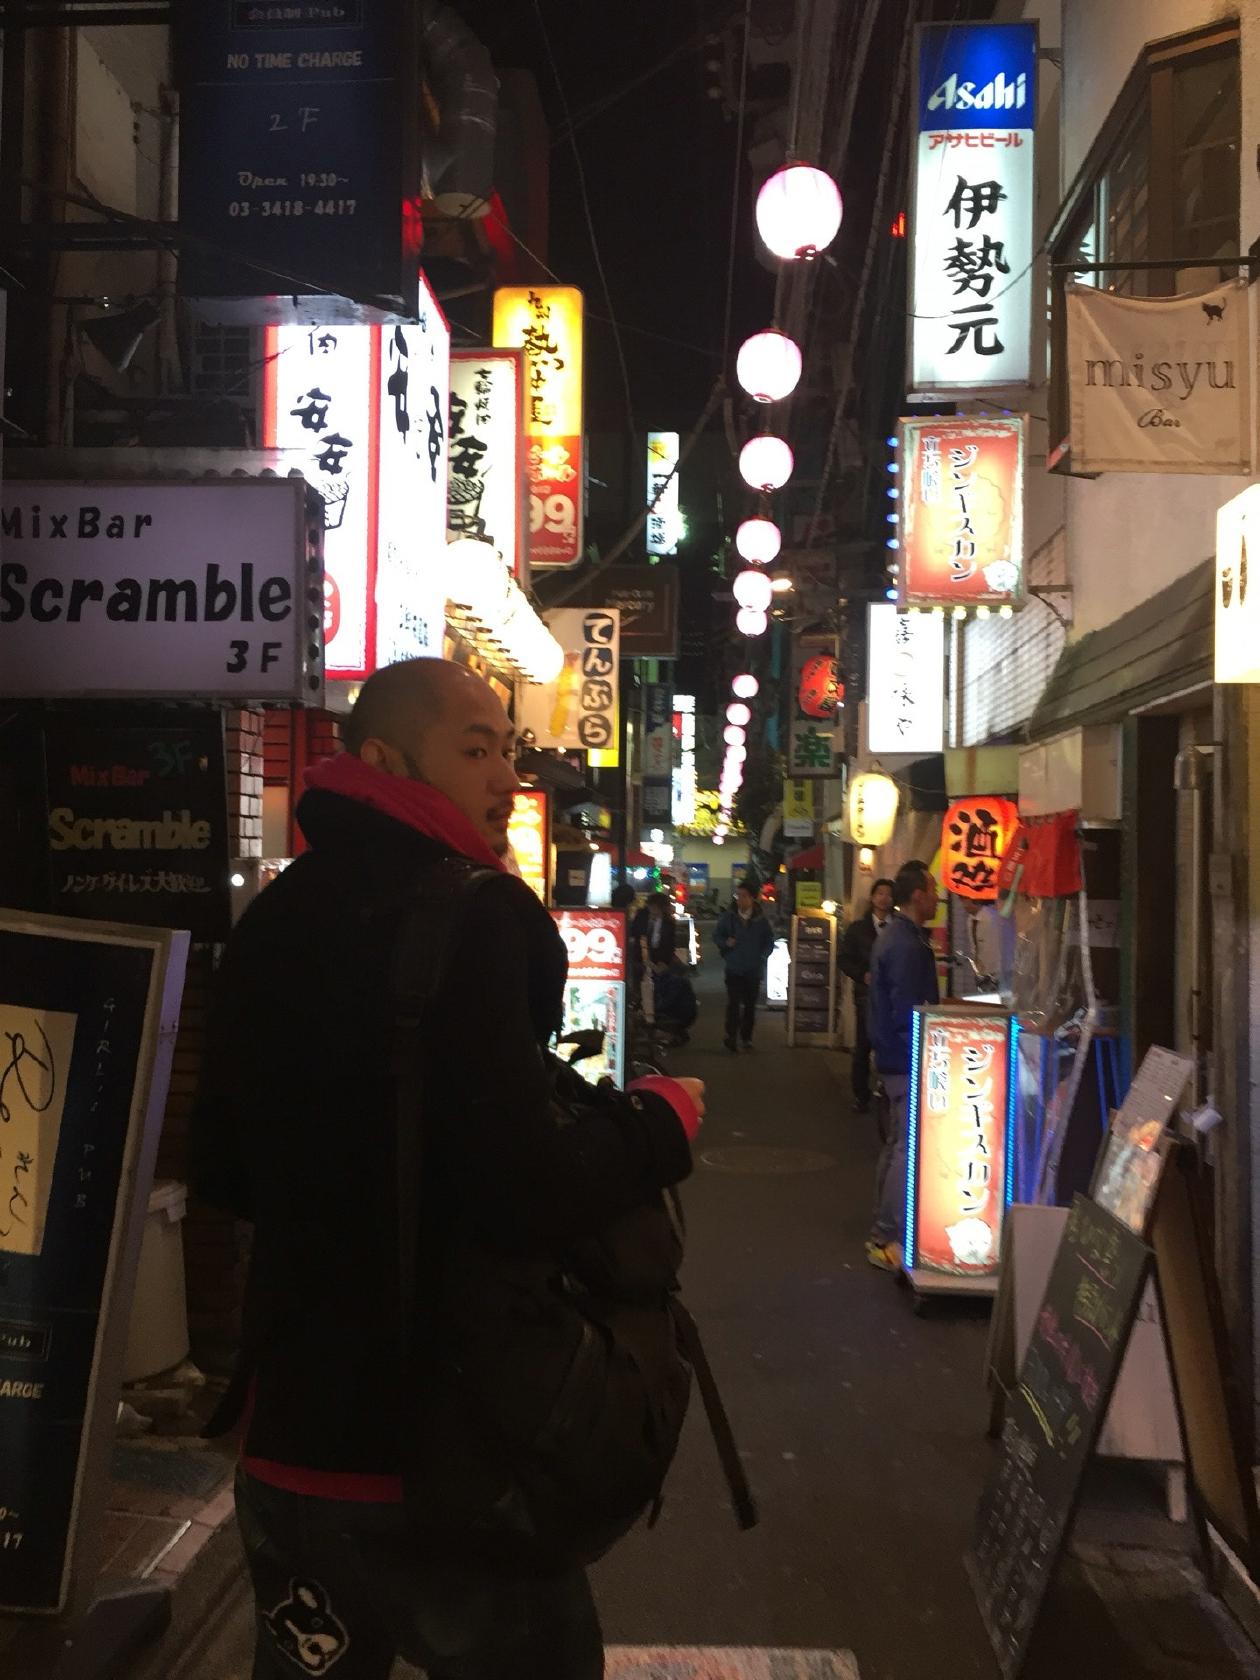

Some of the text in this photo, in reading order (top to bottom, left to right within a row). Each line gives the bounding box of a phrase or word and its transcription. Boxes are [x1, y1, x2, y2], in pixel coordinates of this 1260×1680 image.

[305, 5, 345, 18] Pub
[227, 50, 364, 69] NO TIME CHARGE
[927, 72, 1026, 111] Asahi
[928, 132, 1024, 151] アサヒビール
[237, 171, 288, 190] Open
[229, 199, 357, 217] 03-3418-4417
[943, 174, 1010, 356] 伊勢元
[1085, 352, 1237, 401] misyu
[1136, 408, 1182, 428] Bar
[0, 562, 292, 622] Scramble
[583, 612, 614, 747] てんぷら
[49, 807, 212, 850] Scramble
